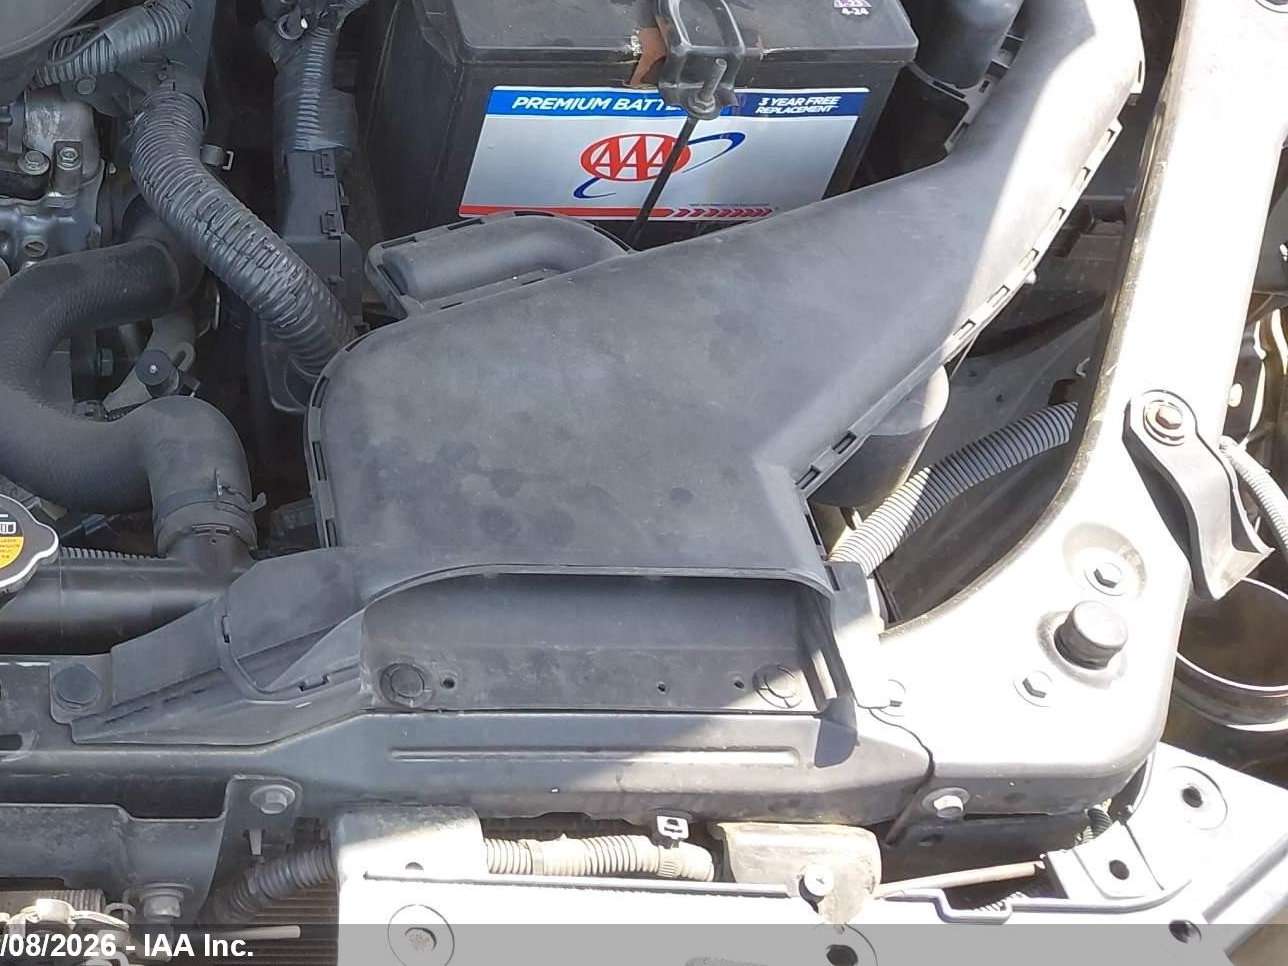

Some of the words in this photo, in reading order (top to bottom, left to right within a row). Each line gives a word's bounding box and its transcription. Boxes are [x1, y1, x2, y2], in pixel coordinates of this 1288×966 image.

[512, 96, 612, 110] PREMIUM
[758, 97, 770, 106] 3
[771, 96, 805, 106] YEAR
[805, 96, 841, 105] FREE
[585, 134, 685, 180] AAA
